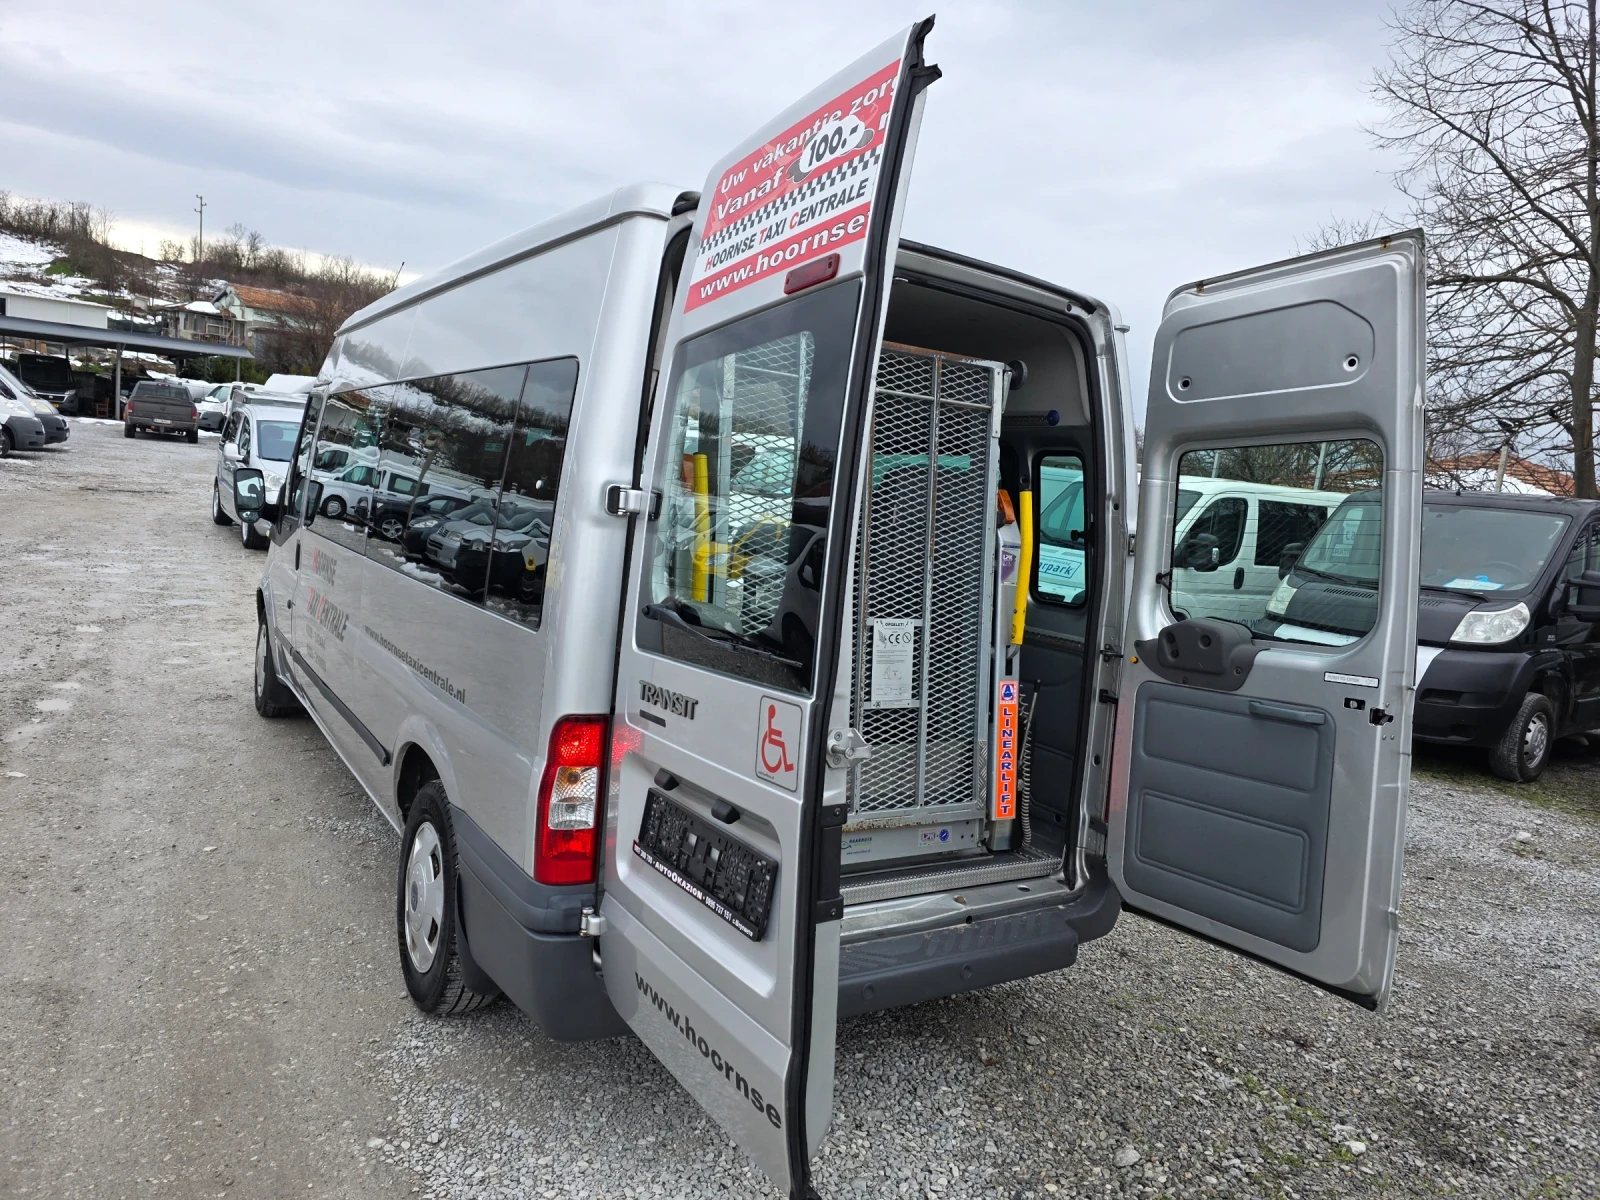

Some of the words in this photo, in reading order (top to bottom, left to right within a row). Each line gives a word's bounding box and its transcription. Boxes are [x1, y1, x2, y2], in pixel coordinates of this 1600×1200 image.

[716, 166, 785, 221] Vanaf
[720, 168, 747, 194] Uw
[753, 109, 842, 172] vakantie
[700, 212, 870, 299] www.hoornse
[705, 236, 755, 272] HOORNSE
[758, 217, 788, 245] TAXI
[788, 178, 869, 230] CENTRALE
[364, 624, 466, 704] www.hoornsetaxicentrale.nl
[638, 680, 698, 720] TRANSIT
[1001, 707, 1013, 814] LINEARLIFT
